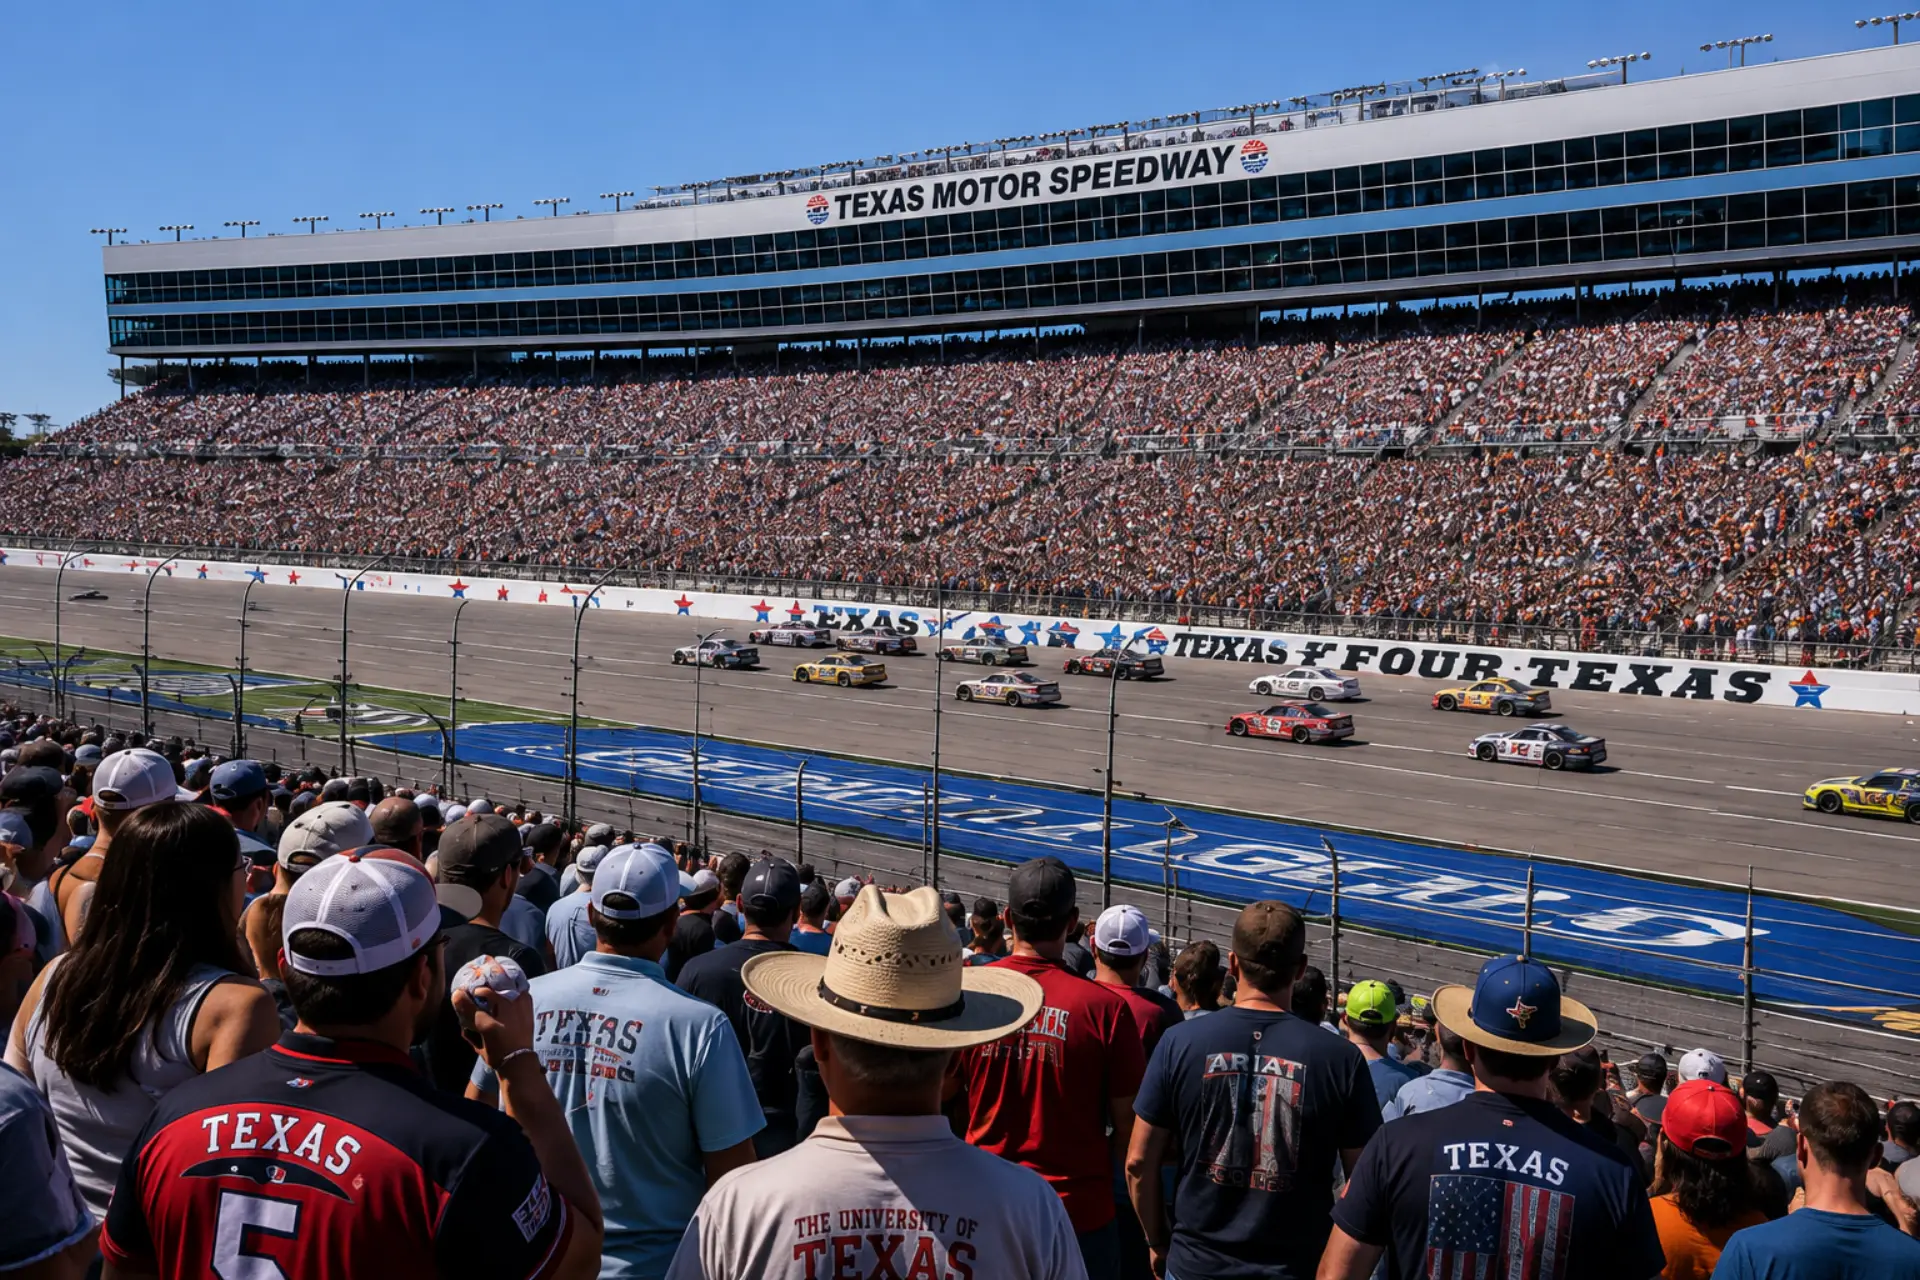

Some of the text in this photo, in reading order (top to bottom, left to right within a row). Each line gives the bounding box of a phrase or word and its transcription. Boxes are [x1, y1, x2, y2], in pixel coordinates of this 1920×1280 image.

[834, 144, 1236, 220] TEXAS MOTOR SPEEDWAY
[1340, 644, 1503, 681] FOUR
[1528, 657, 1772, 704] TEXAS
[1207, 1052, 1304, 1079] ARIAT
[202, 1111, 362, 1176] TEXAS
[1443, 1142, 1570, 1186] TEXAS
[211, 1188, 301, 1280] 5
[794, 1208, 979, 1239] THE UNIVERSITY OF
[793, 1234, 978, 1280] TEXAS
